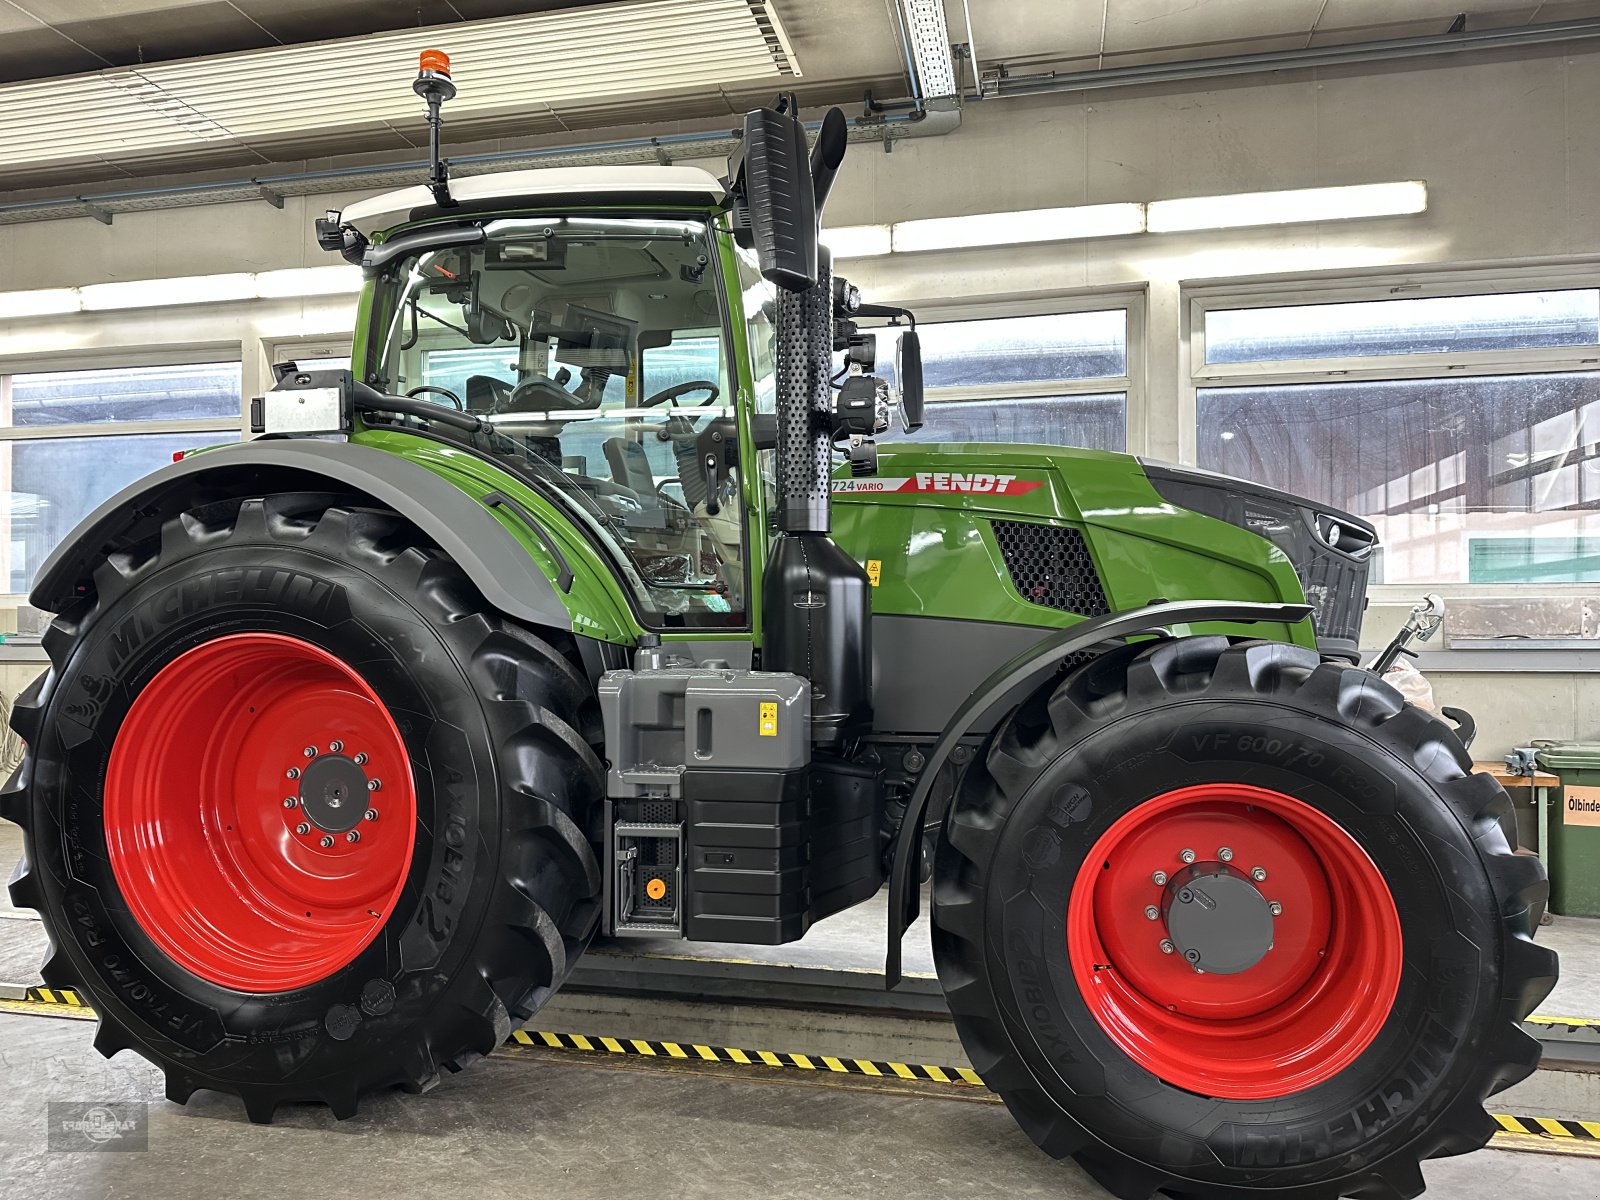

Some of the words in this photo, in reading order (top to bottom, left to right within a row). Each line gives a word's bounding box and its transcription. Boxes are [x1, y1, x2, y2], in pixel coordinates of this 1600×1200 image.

[832, 481, 855, 491] 724
[856, 482, 884, 491] VARIO
[915, 472, 1017, 492] FENDT
[106, 568, 337, 675] MICHELIN
[1191, 733, 1231, 751] VF
[1236, 735, 1326, 768] 600/70
